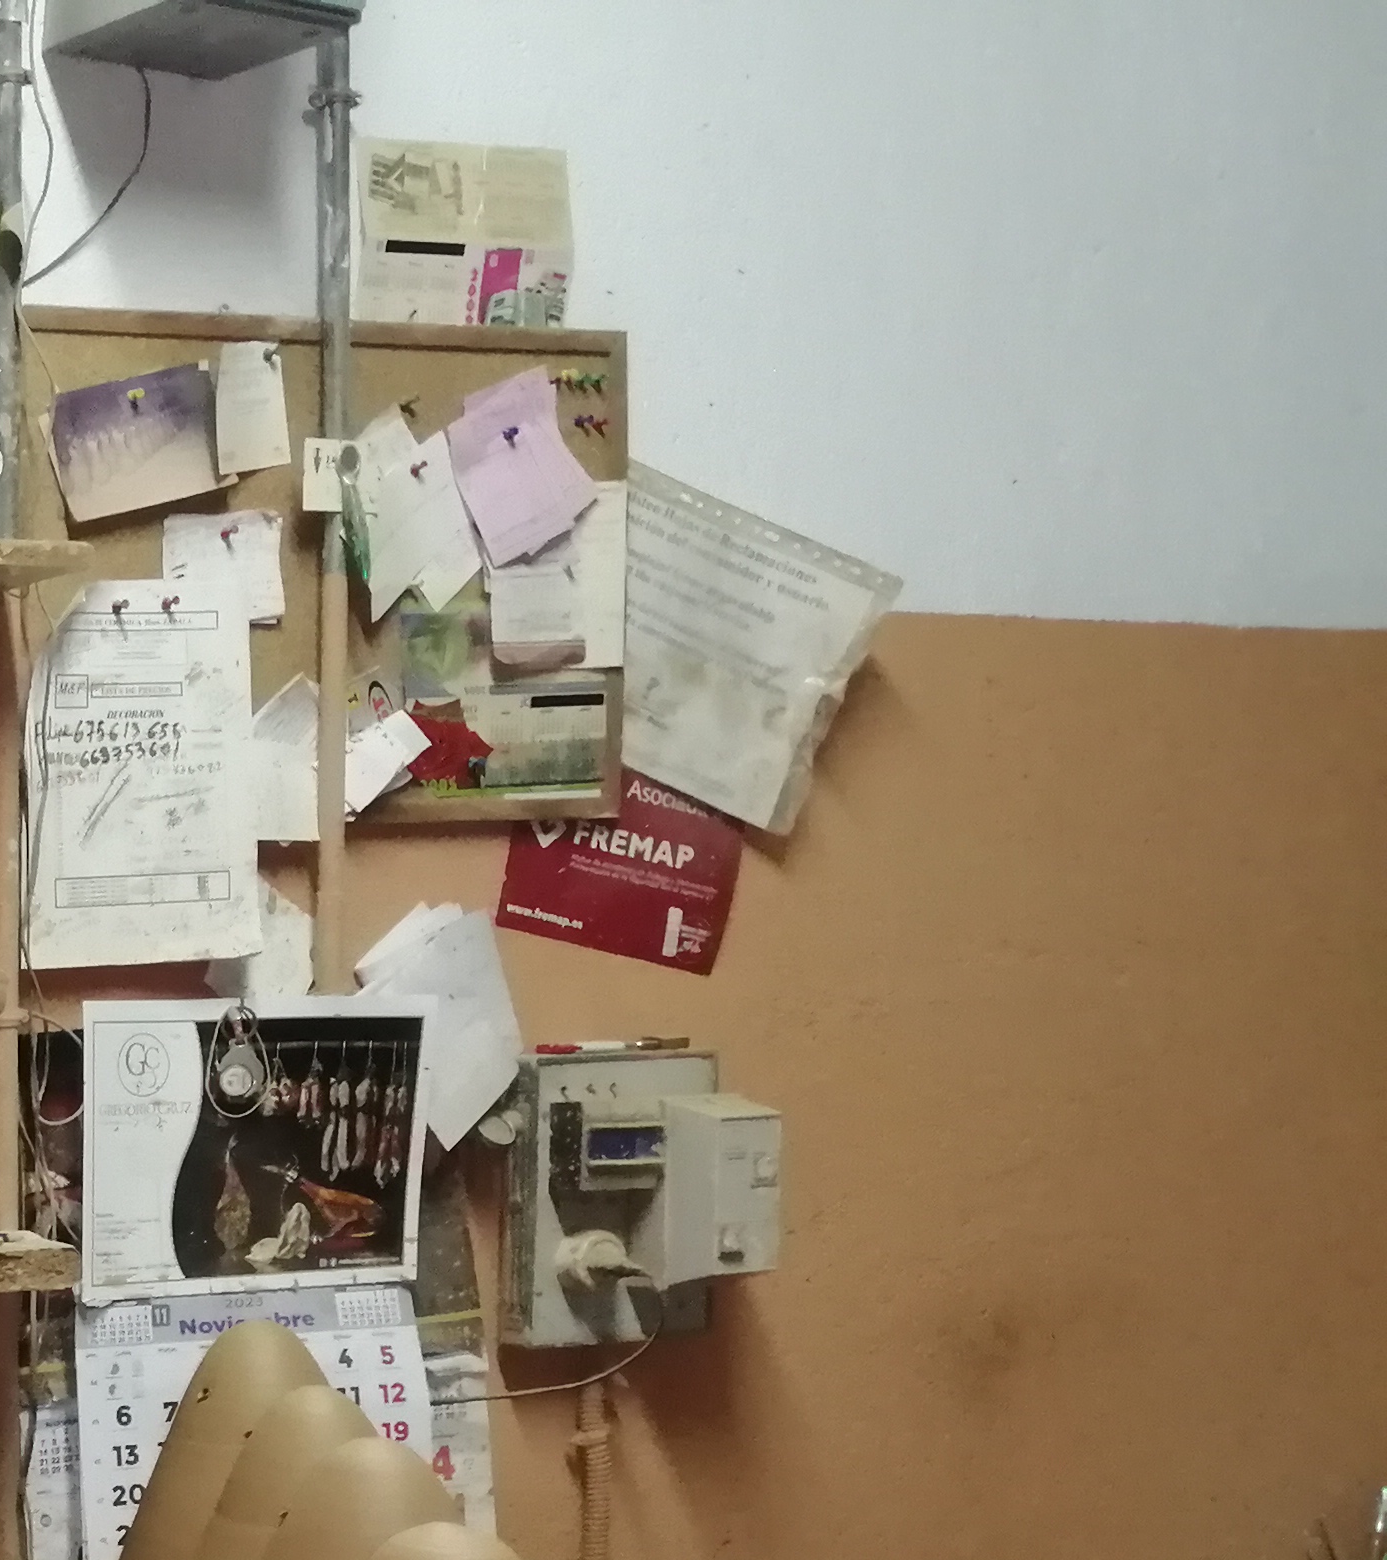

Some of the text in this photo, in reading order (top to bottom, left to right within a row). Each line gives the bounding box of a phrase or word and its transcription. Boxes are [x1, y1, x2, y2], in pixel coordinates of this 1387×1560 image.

[572, 820, 695, 870] FREMAP
[179, 1312, 315, 1336] Novibre
[338, 1345, 395, 1369] 4 5
[115, 1404, 132, 1426] 6
[378, 1382, 406, 1404] 12
[112, 1421, 409, 1467] 13 19
[431, 1444, 456, 1481] 4
[112, 1484, 146, 1507] 20
